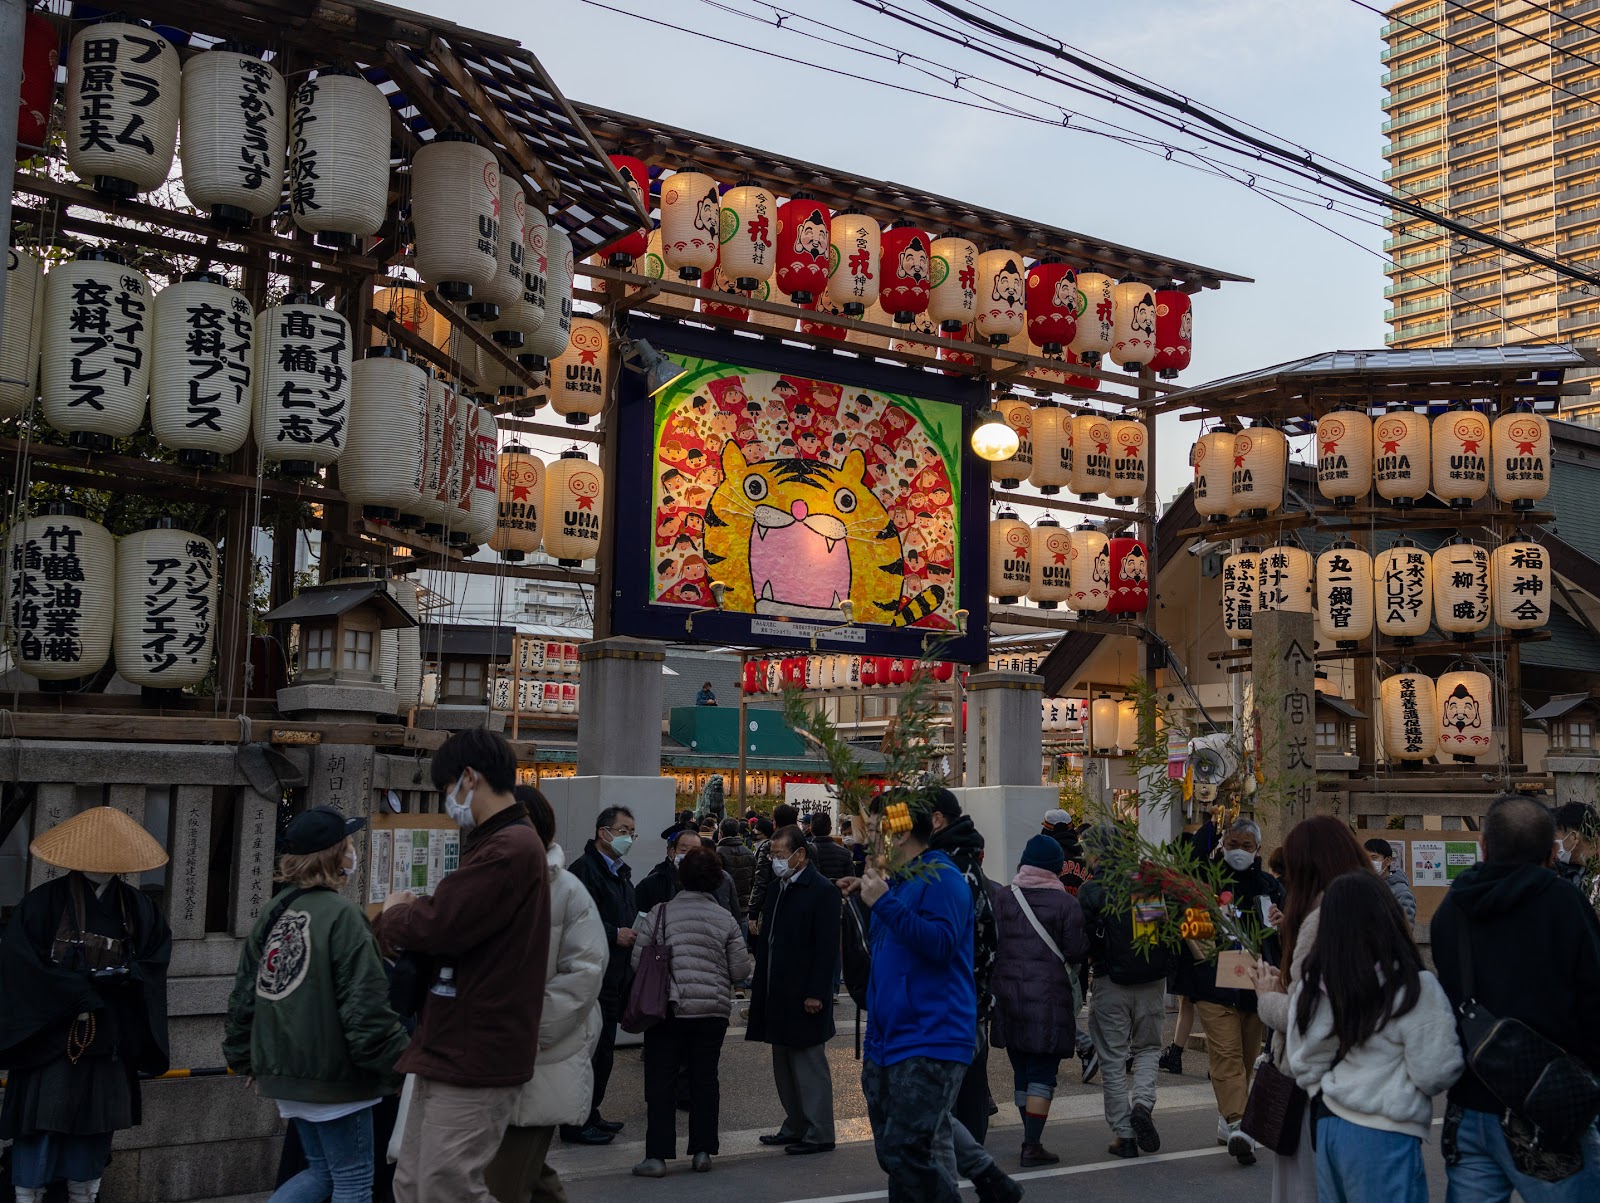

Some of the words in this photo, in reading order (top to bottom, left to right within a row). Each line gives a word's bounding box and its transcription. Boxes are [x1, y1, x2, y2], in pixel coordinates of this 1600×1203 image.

[79, 38, 120, 152] 田原正夫
[116, 34, 166, 156] プラム
[747, 193, 772, 266] 今宮戎神社
[849, 227, 874, 297] 今宮戎神社
[959, 245, 977, 310] 今宮戎神社
[113, 274, 146, 387] (株)セイコー
[1096, 279, 1114, 342] 今宮戎神社
[68, 278, 114, 411] 衣料プレス
[185, 302, 228, 432] 衣料プレス
[566, 365, 602, 384] UHA
[313, 314, 347, 448] コイサンズ
[565, 381, 602, 396] 味覚糖
[1115, 458, 1145, 472] UHA
[1115, 470, 1145, 482] 味覚糖
[1318, 455, 1348, 473] UHA
[1318, 469, 1349, 482] 味覚糖
[1377, 454, 1411, 472] UHA
[1377, 469, 1412, 482] 味覚糖
[1450, 454, 1485, 472] UHA
[1450, 470, 1485, 482] 味覚糖
[1506, 457, 1543, 472] UHA
[1506, 471, 1544, 481] 味覚糖
[498, 502, 537, 520] UHA
[563, 527, 599, 541] 味覚糖
[564, 511, 599, 530] UHA
[41, 525, 85, 662] 竹鶴油業(株)
[1269, 553, 1290, 610] (株)ナル
[1328, 555, 1353, 628] 丸一鋼管
[1405, 553, 1425, 618] 風水メンター
[1510, 548, 1544, 621] 福神会
[142, 558, 182, 673] アソシエイツ
[1041, 703, 1078, 722] 会社
[1399, 678, 1424, 753] 家庭養護促進協会
[249, 809, 265, 919] 玉置産業株式会社
